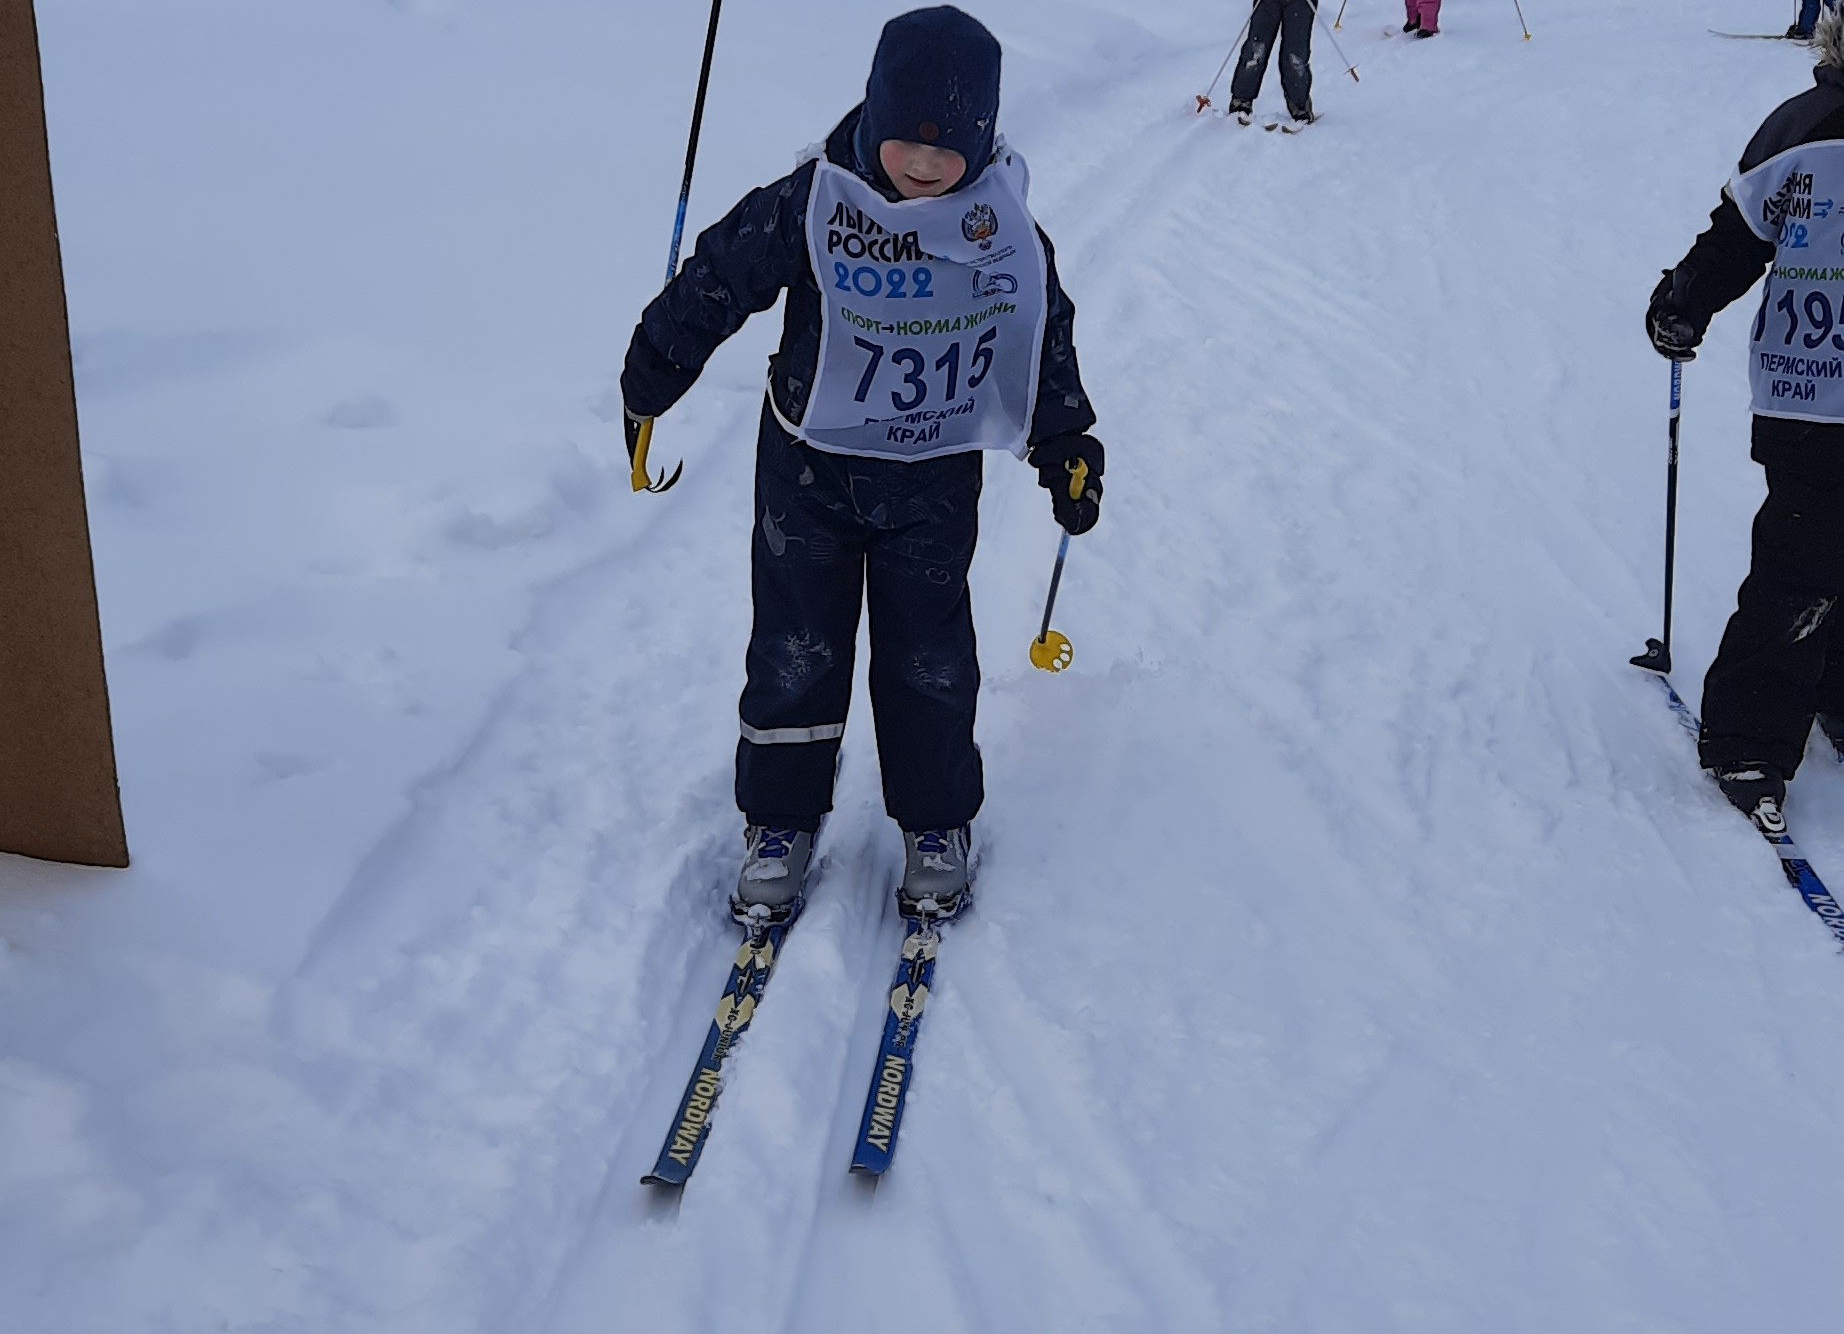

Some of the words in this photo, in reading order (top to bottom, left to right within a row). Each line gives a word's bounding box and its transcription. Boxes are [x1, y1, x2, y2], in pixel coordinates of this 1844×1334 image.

[834, 261, 934, 299] 2022
[1779, 267, 1828, 281] НОРМА
[841, 306, 882, 335] СПОРТ
[896, 316, 961, 336] НОРМА
[963, 301, 1017, 331] ЖИЗНИ
[853, 325, 997, 412] 7315
[1760, 352, 1843, 379] ПЕРМСКИЙ
[1771, 379, 1816, 401] КРАЙ
[886, 421, 941, 445] КРАЙ
[667, 1067, 721, 1167] NORDWAY
[866, 1053, 907, 1154] NORDWAY
